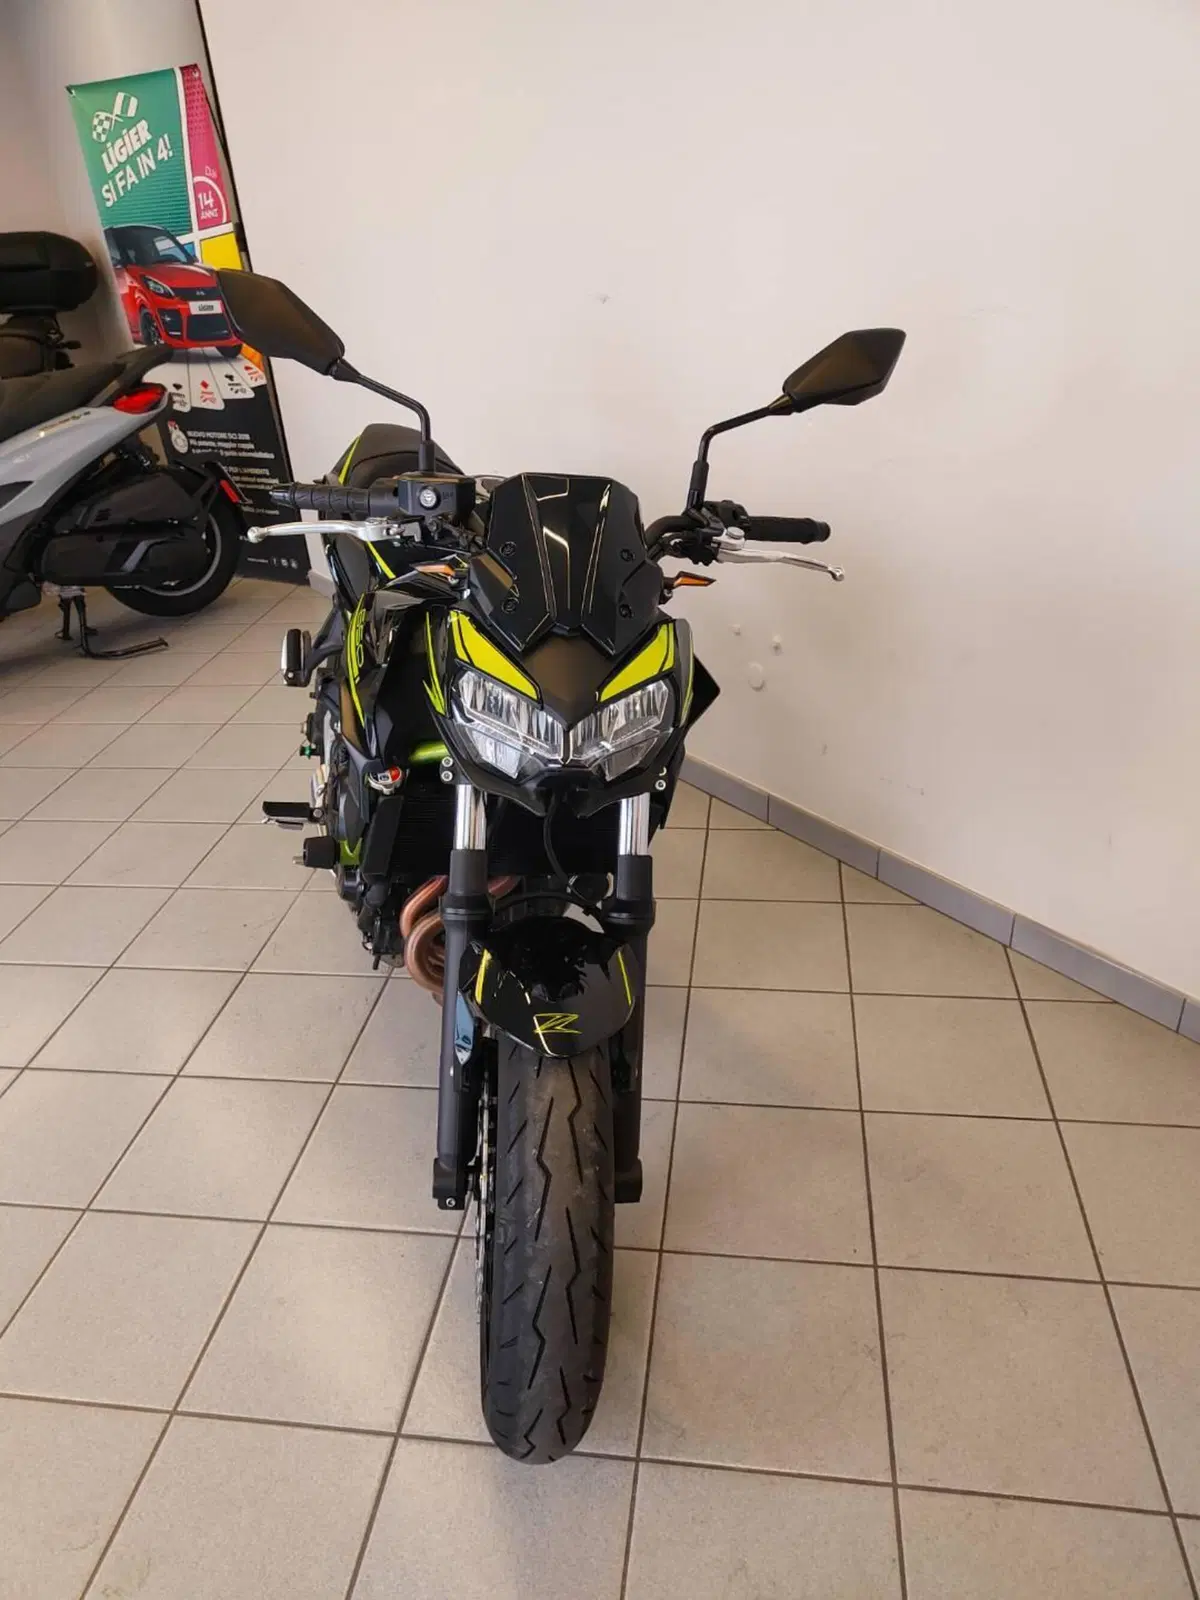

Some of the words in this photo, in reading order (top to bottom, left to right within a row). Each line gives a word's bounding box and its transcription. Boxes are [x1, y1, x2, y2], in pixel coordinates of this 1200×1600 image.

[101, 180, 118, 208] SI
[115, 165, 139, 197] FA
[136, 147, 157, 179] IN
[157, 132, 173, 161] 4!
[198, 190, 214, 210] 14
